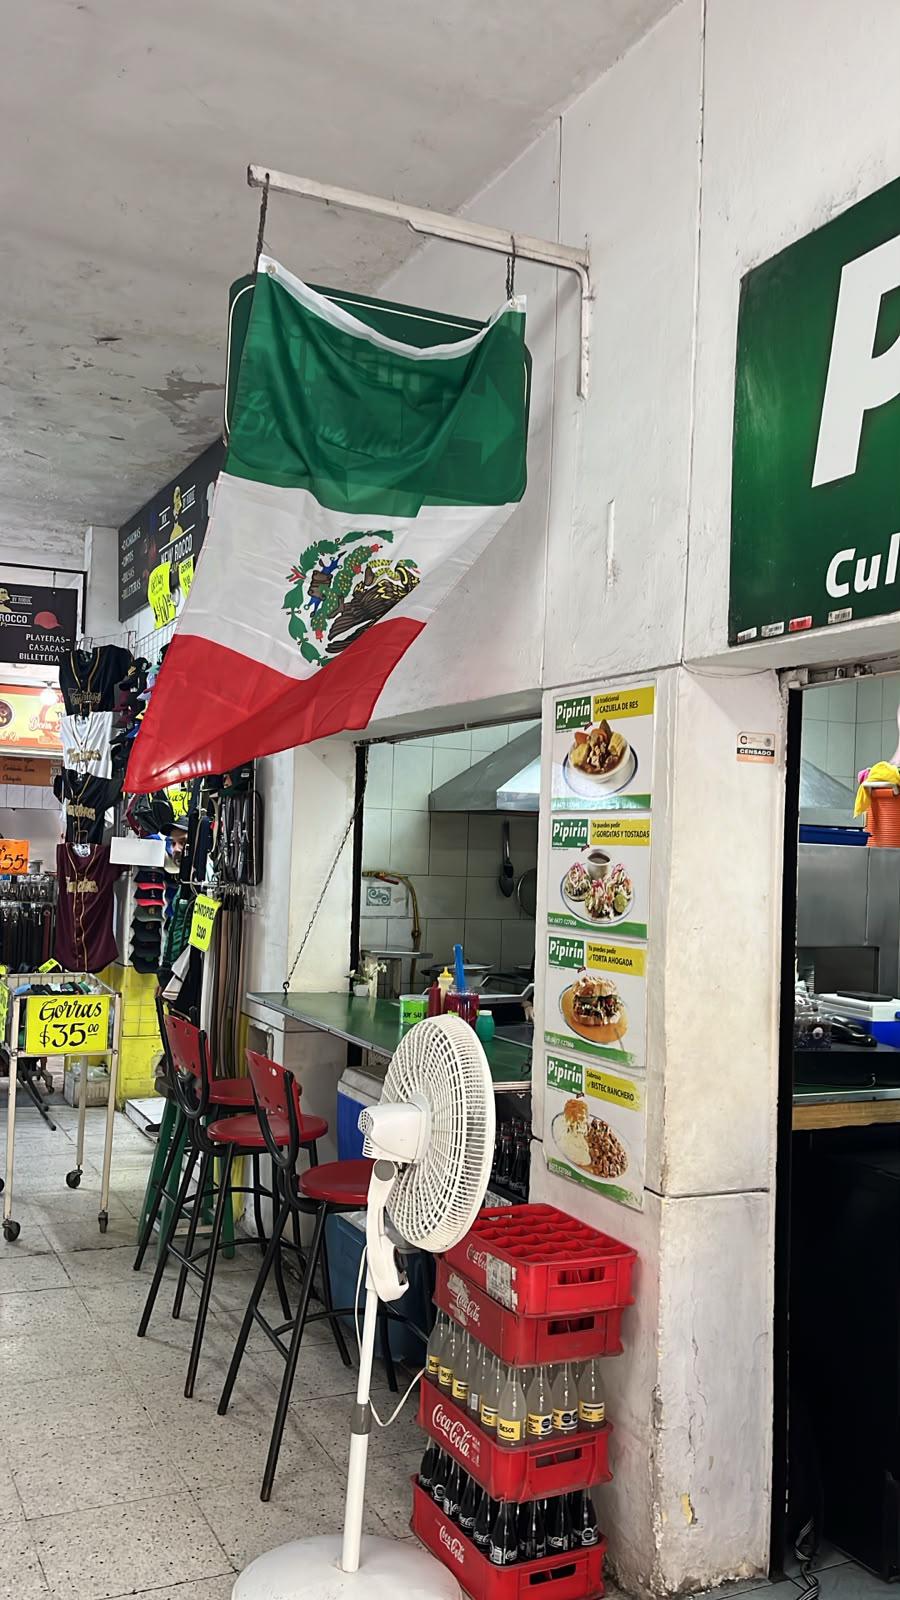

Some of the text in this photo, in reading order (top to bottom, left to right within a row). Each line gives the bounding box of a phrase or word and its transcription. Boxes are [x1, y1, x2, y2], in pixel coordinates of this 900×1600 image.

[174, 533, 193, 561] ROCCO
[825, 532, 900, 599] Cul
[0, 613, 28, 624] ROCCO
[556, 700, 591, 724] Pipirín
[600, 700, 639, 714] CAZUELA DE RES
[740, 748, 772, 756] CENSADO
[552, 821, 588, 842] Pipirín
[596, 830, 620, 838] GORDITAS
[624, 830, 650, 838] TOSTADAS
[550, 940, 584, 961] Pipirín
[592, 954, 633, 967] TORTA AHOGADA
[39, 999, 102, 1022] Gorras
[548, 1060, 582, 1084] Pipirín
[591, 1081, 607, 1093] BISTEC
[607, 1087, 635, 1102] RANCHERO
[432, 1404, 472, 1457] Coca-Cola
